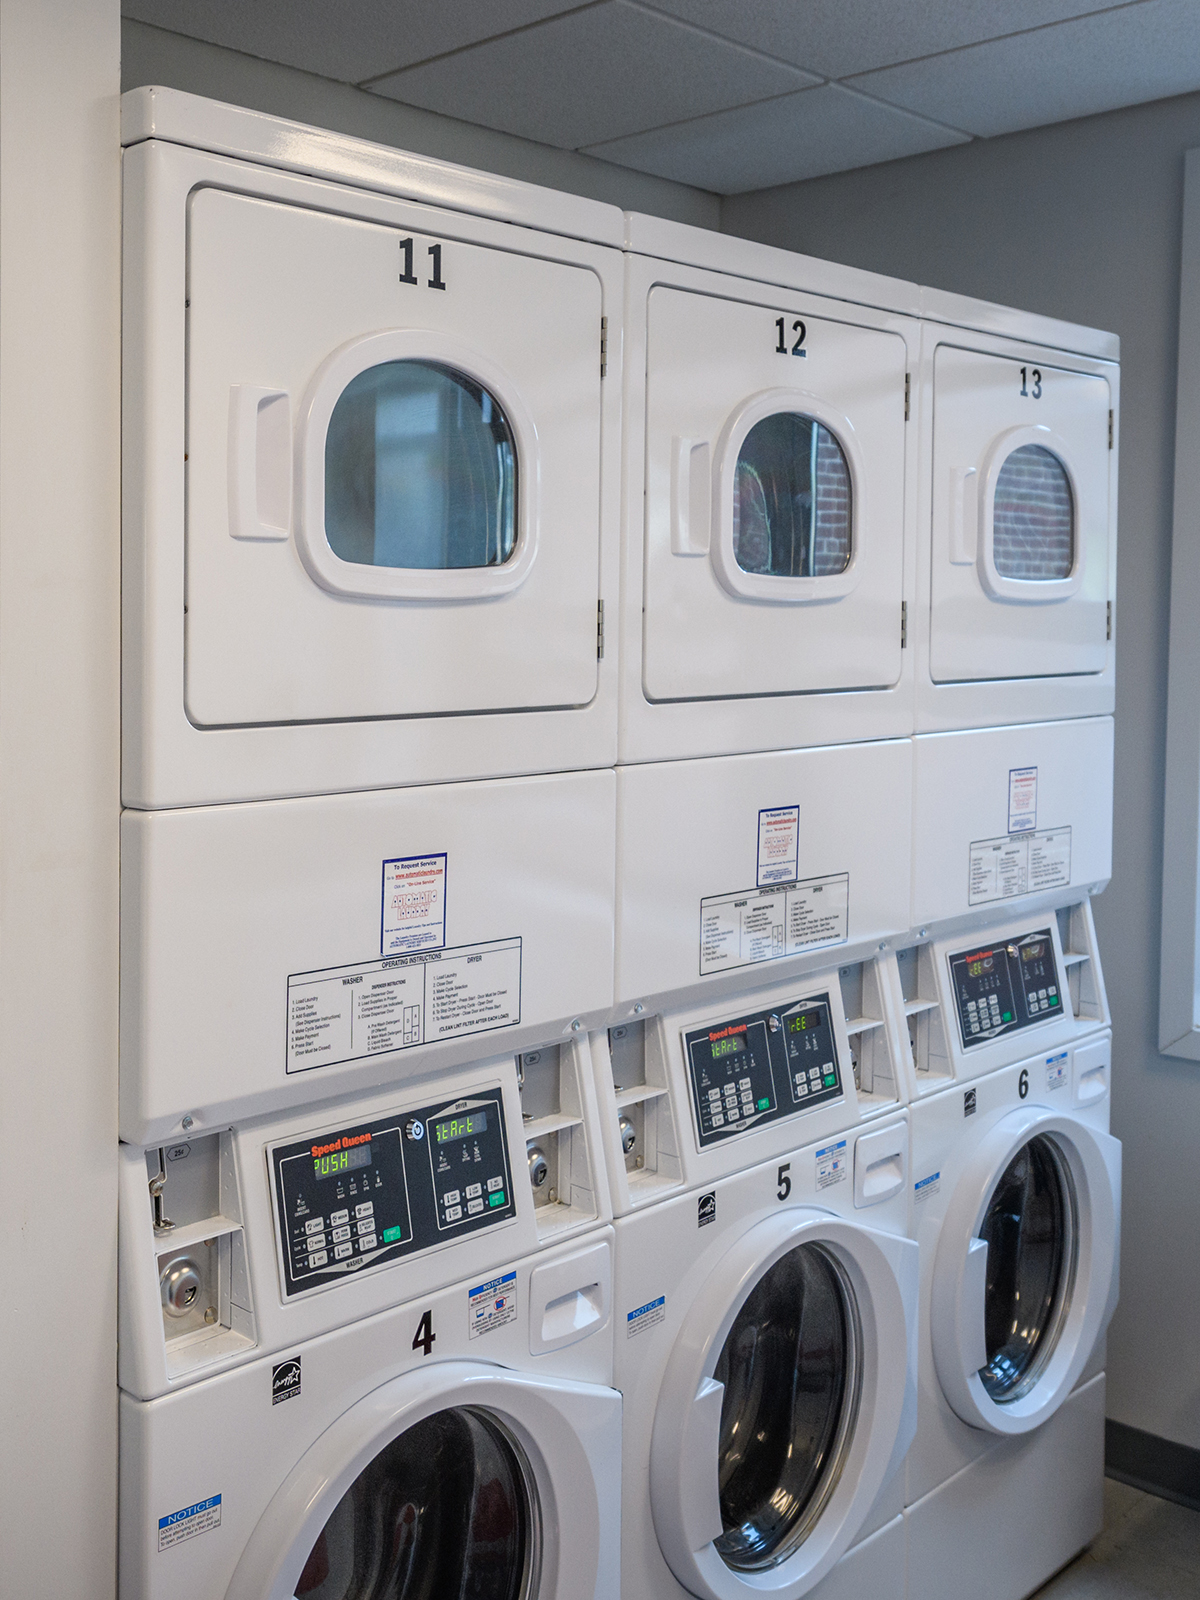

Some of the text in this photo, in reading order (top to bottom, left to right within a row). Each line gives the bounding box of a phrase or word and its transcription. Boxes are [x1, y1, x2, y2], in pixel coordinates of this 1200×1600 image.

[399, 237, 446, 291] 11
[775, 316, 807, 358] 12
[1020, 366, 1042, 399] 13
[392, 889, 437, 908] AUTOMATIC
[397, 903, 430, 920] LAUNDRY
[382, 952, 441, 968] OPERATING INSTRUCTIONS
[467, 955, 482, 964] DRYER
[343, 976, 363, 986] WASHER
[439, 1024, 453, 1033] (CLEAN
[709, 1024, 747, 1042] Speed Queen
[1018, 1069, 1029, 1099] 6
[455, 1101, 467, 1110] DRYER
[311, 1133, 372, 1157] Speed Queen
[776, 1163, 791, 1201] 5
[346, 1257, 364, 1269] WASHER
[483, 1278, 502, 1290] NOTICE
[632, 1300, 660, 1318] NOTICE
[412, 1310, 436, 1356] 4
[168, 1498, 214, 1524] NOTICE
